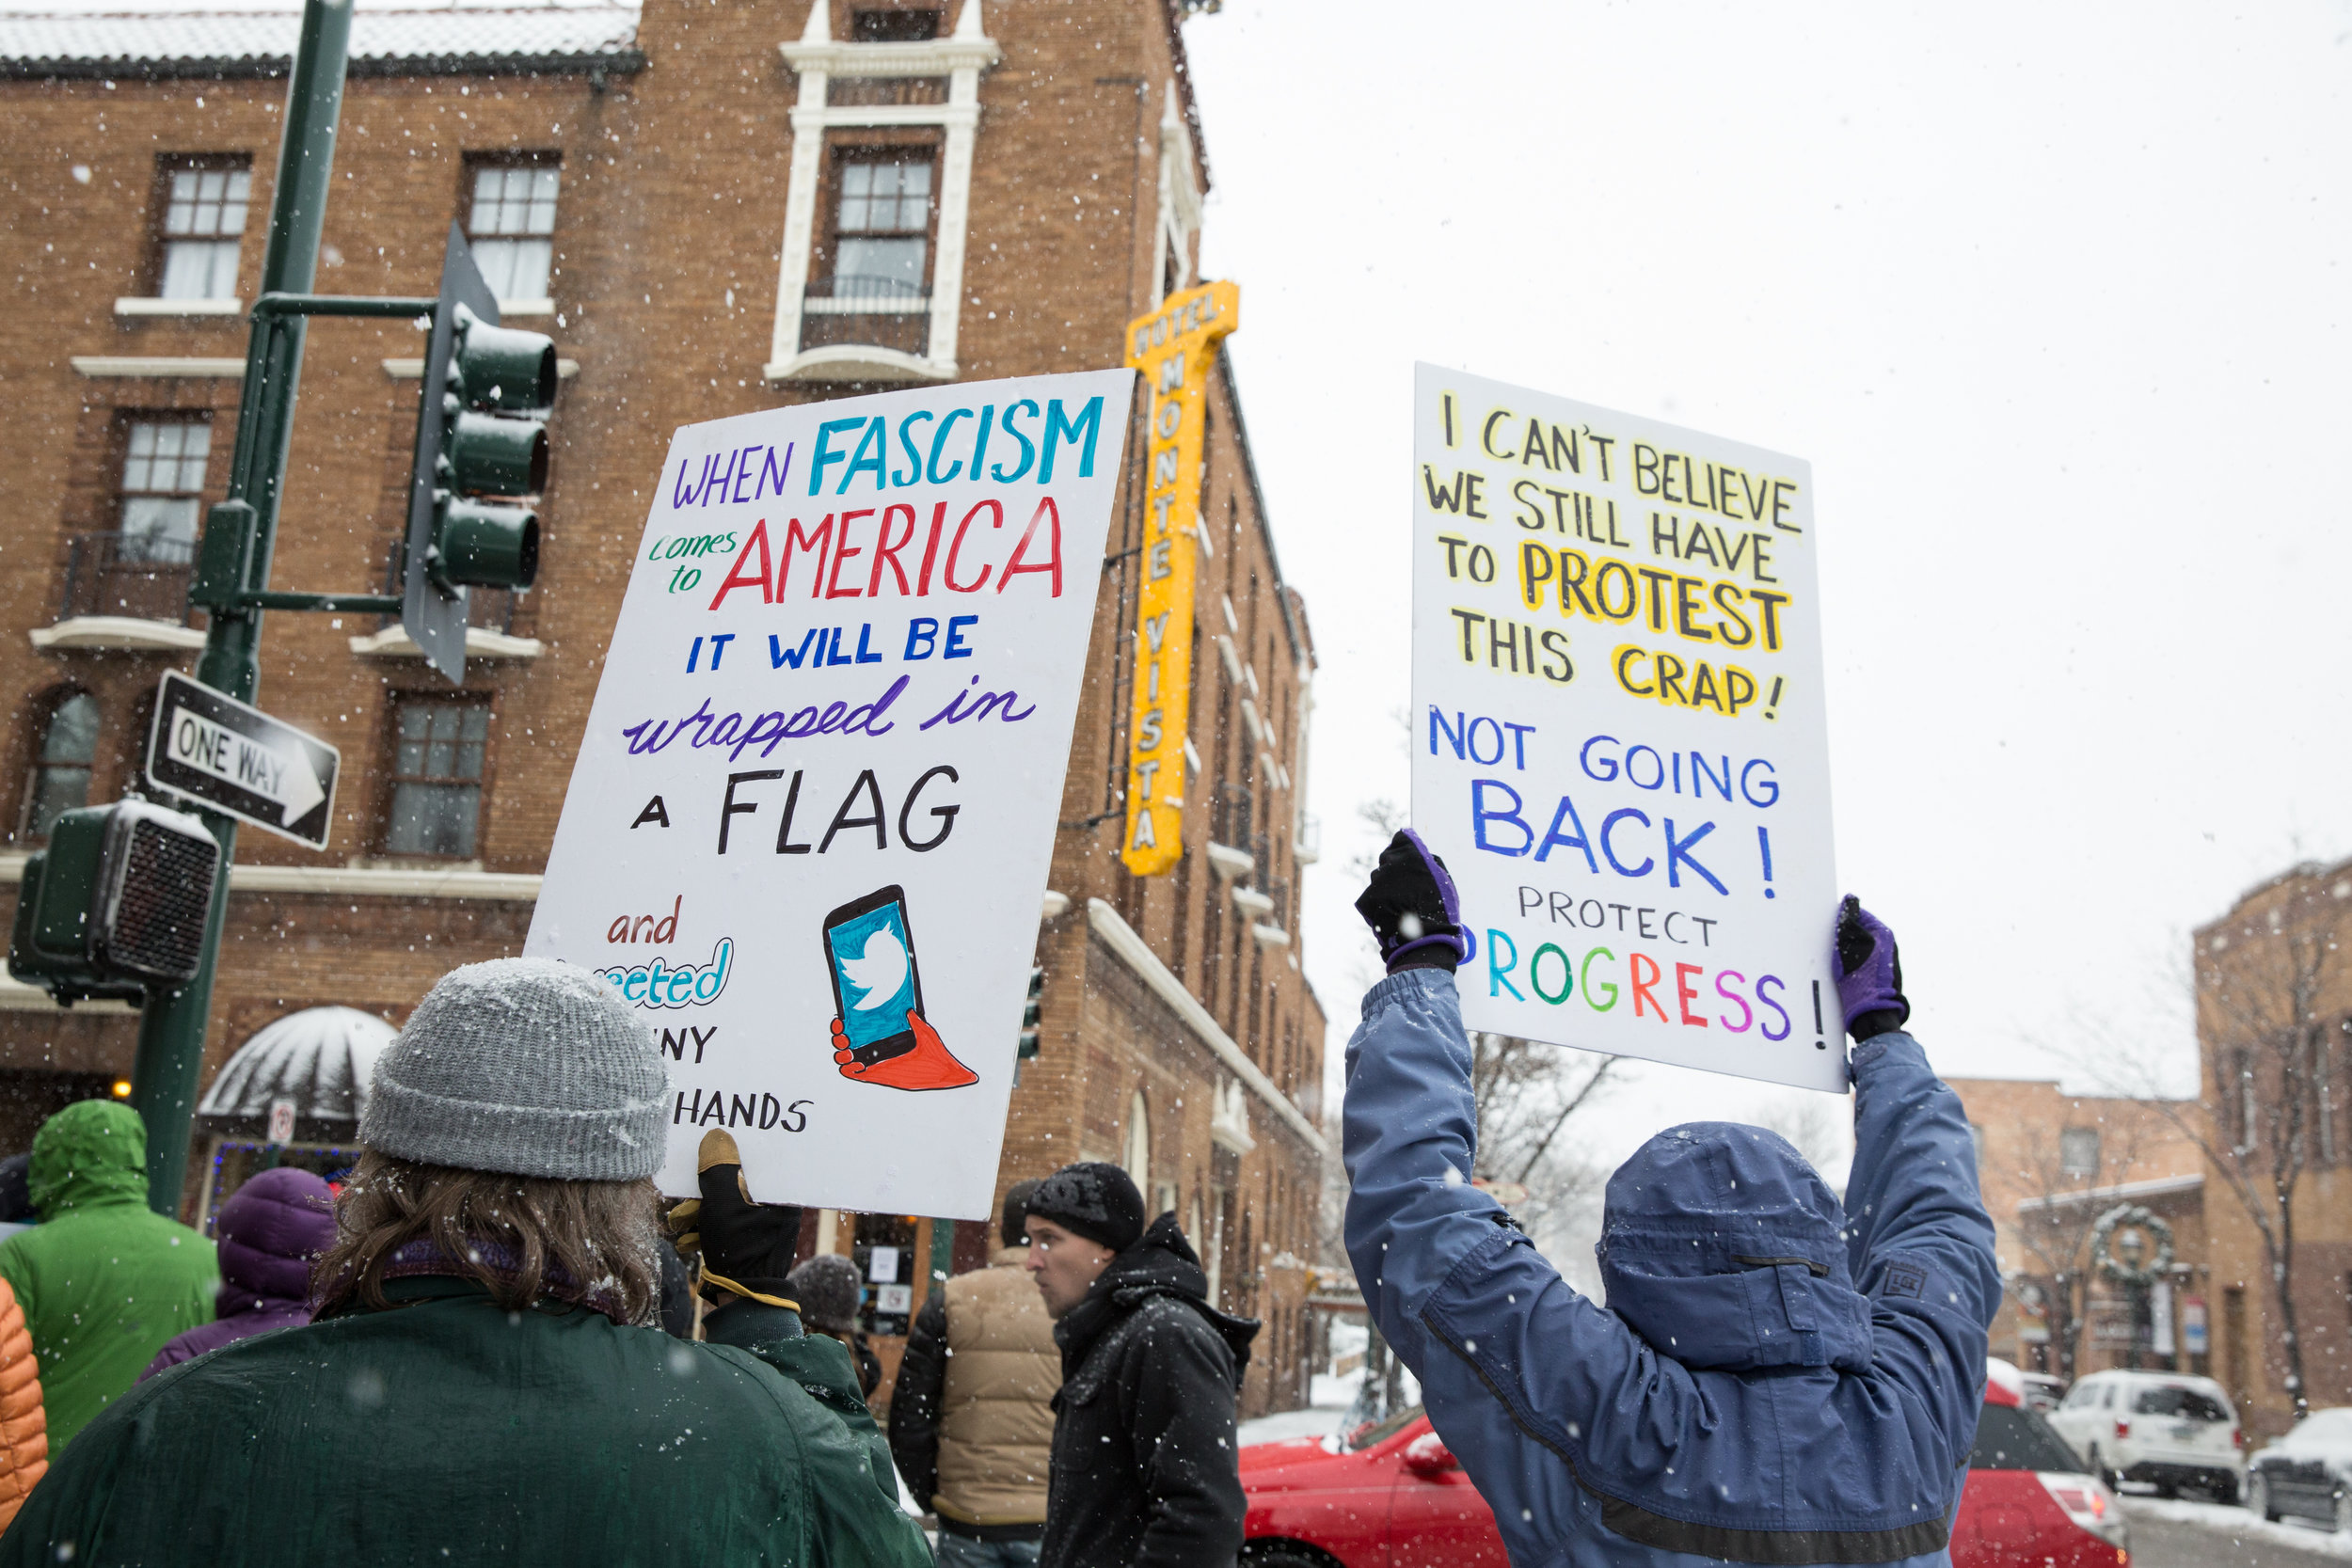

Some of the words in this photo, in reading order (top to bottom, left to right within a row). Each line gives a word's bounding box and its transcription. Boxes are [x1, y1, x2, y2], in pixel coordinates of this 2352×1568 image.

[1135, 292, 1218, 354] HOTEL
[673, 441, 794, 509] WHEN
[808, 396, 1104, 496] FASCISM
[1149, 350, 1185, 581] MONTE
[1443, 394, 1454, 447] I
[1484, 410, 1614, 482] CAN'T
[1633, 443, 1803, 533] BELIEVE
[648, 530, 739, 562] comes
[707, 497, 1063, 611] AMERICA
[1423, 465, 1487, 519] WE
[1513, 481, 1629, 548] STILL
[1651, 513, 1778, 583] HAVE
[668, 563, 702, 594] to
[1438, 536, 1496, 583] TO
[1522, 542, 1788, 651] PROTEST
[685, 633, 736, 674] IT
[769, 623, 882, 670] WILL
[903, 614, 979, 661] BE
[1451, 608, 1574, 683] THIS
[1617, 648, 1784, 721] CRAP!
[179, 719, 230, 772] ONE
[238, 741, 287, 795] WAY
[622, 674, 911, 763] wrapped
[919, 674, 1037, 731] in
[1132, 611, 1170, 851] VISTA
[1429, 704, 1536, 770] NOT
[1580, 735, 1781, 808] GOING
[630, 795, 671, 829] A
[717, 765, 961, 855] FLAG
[607, 895, 683, 944] and
[1518, 886, 1718, 947] PROTECT
[673, 1088, 815, 1132] HANDS
